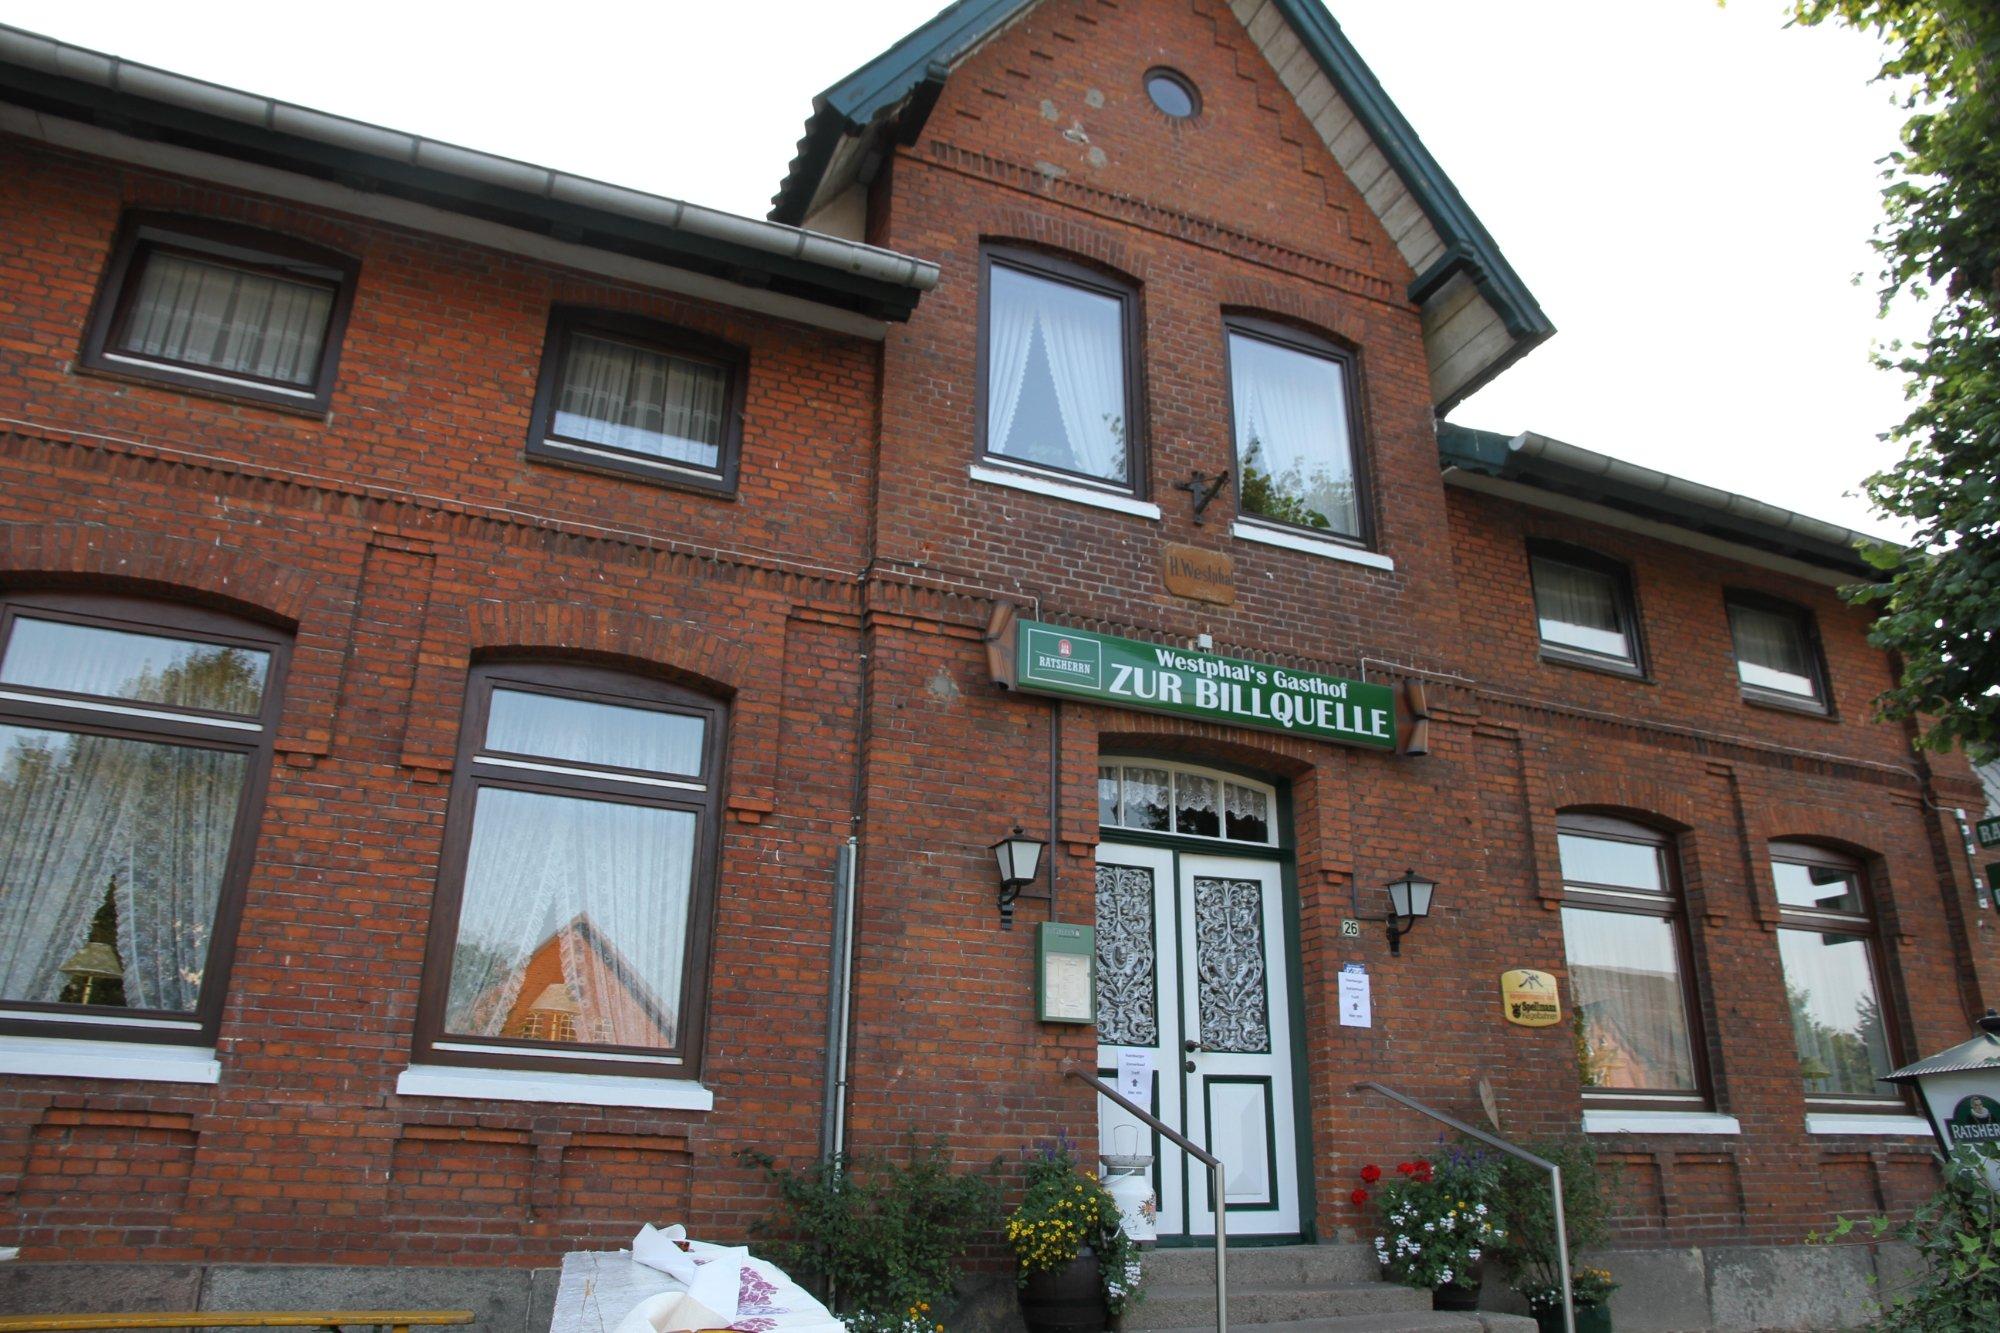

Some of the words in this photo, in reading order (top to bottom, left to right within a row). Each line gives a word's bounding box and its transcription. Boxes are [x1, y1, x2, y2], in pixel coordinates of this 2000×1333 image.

[1038, 655, 1091, 675] RATSHERRN
[1273, 670, 1348, 699] Gasthof
[1109, 663, 1183, 704] ZUR
[1195, 677, 1390, 739] BILLQUELLE
[1344, 921, 1358, 935] 26
